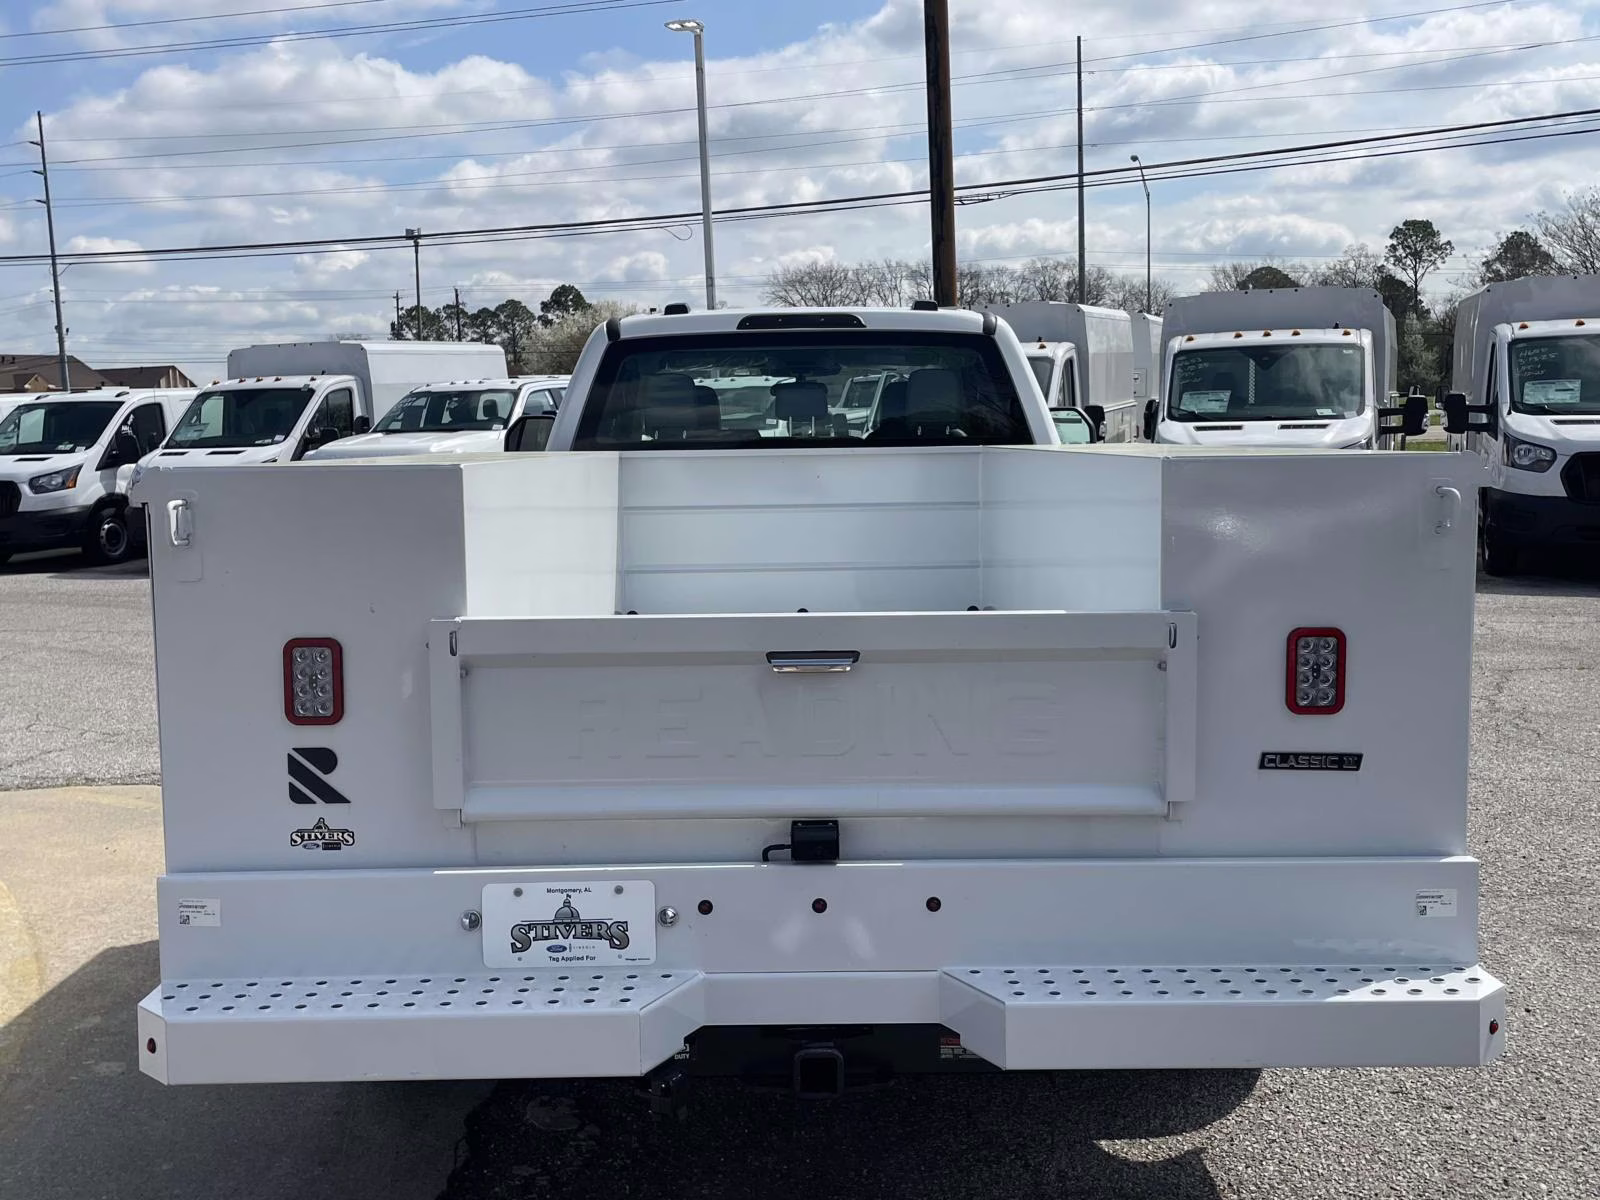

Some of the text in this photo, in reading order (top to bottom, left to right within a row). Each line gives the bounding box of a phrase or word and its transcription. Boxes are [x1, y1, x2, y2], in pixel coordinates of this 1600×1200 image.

[568, 682, 1062, 759] READING
[1264, 754, 1339, 769] CLASSIC
[291, 831, 355, 846] STIVERS
[510, 920, 630, 954] STIVERS
